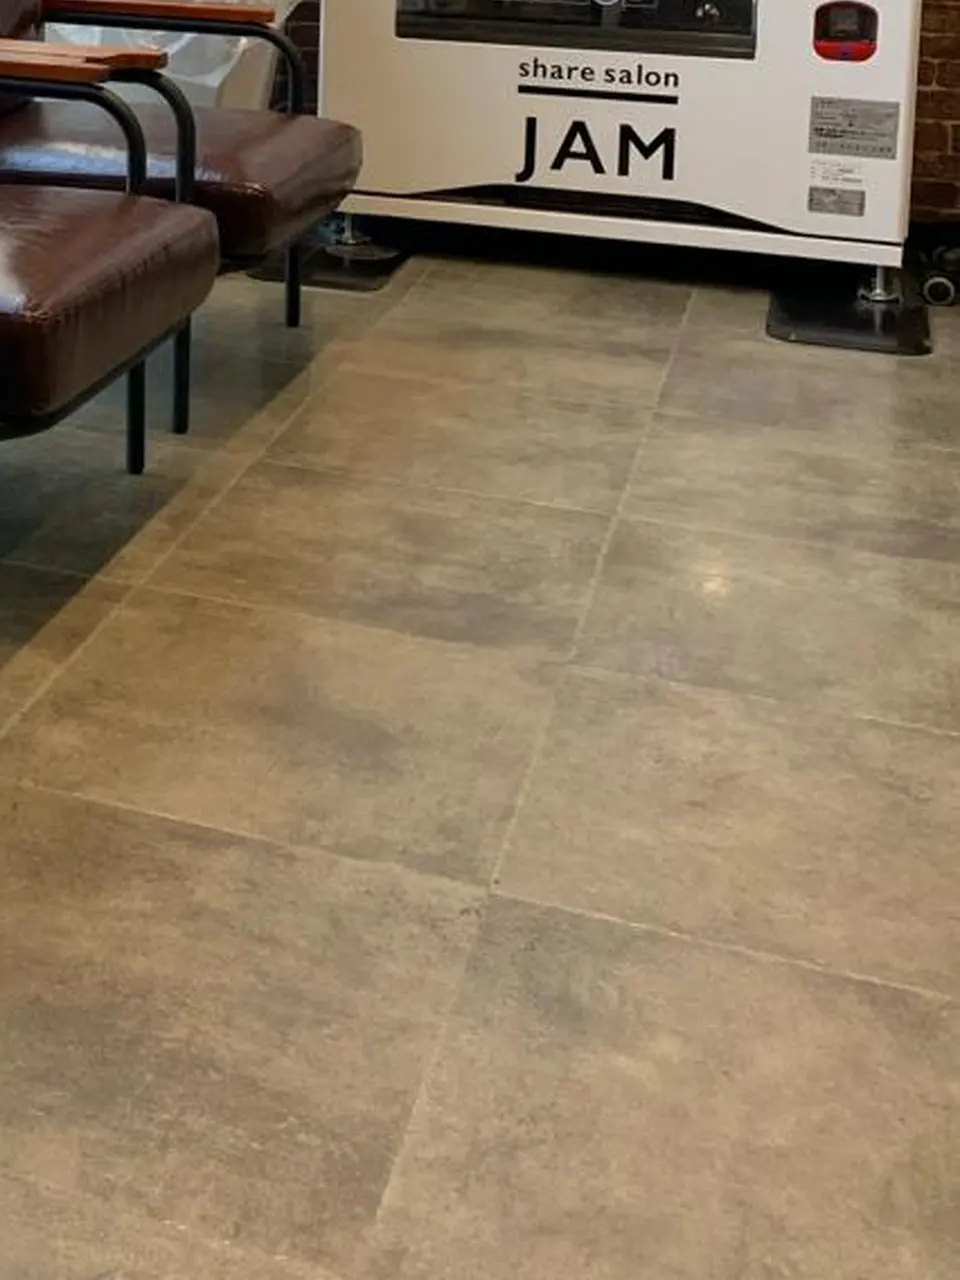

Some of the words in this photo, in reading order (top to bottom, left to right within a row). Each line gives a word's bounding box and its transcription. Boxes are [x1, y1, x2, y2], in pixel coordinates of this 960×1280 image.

[518, 57, 596, 82] share
[603, 64, 680, 88] salon
[514, 116, 677, 183] JAM
